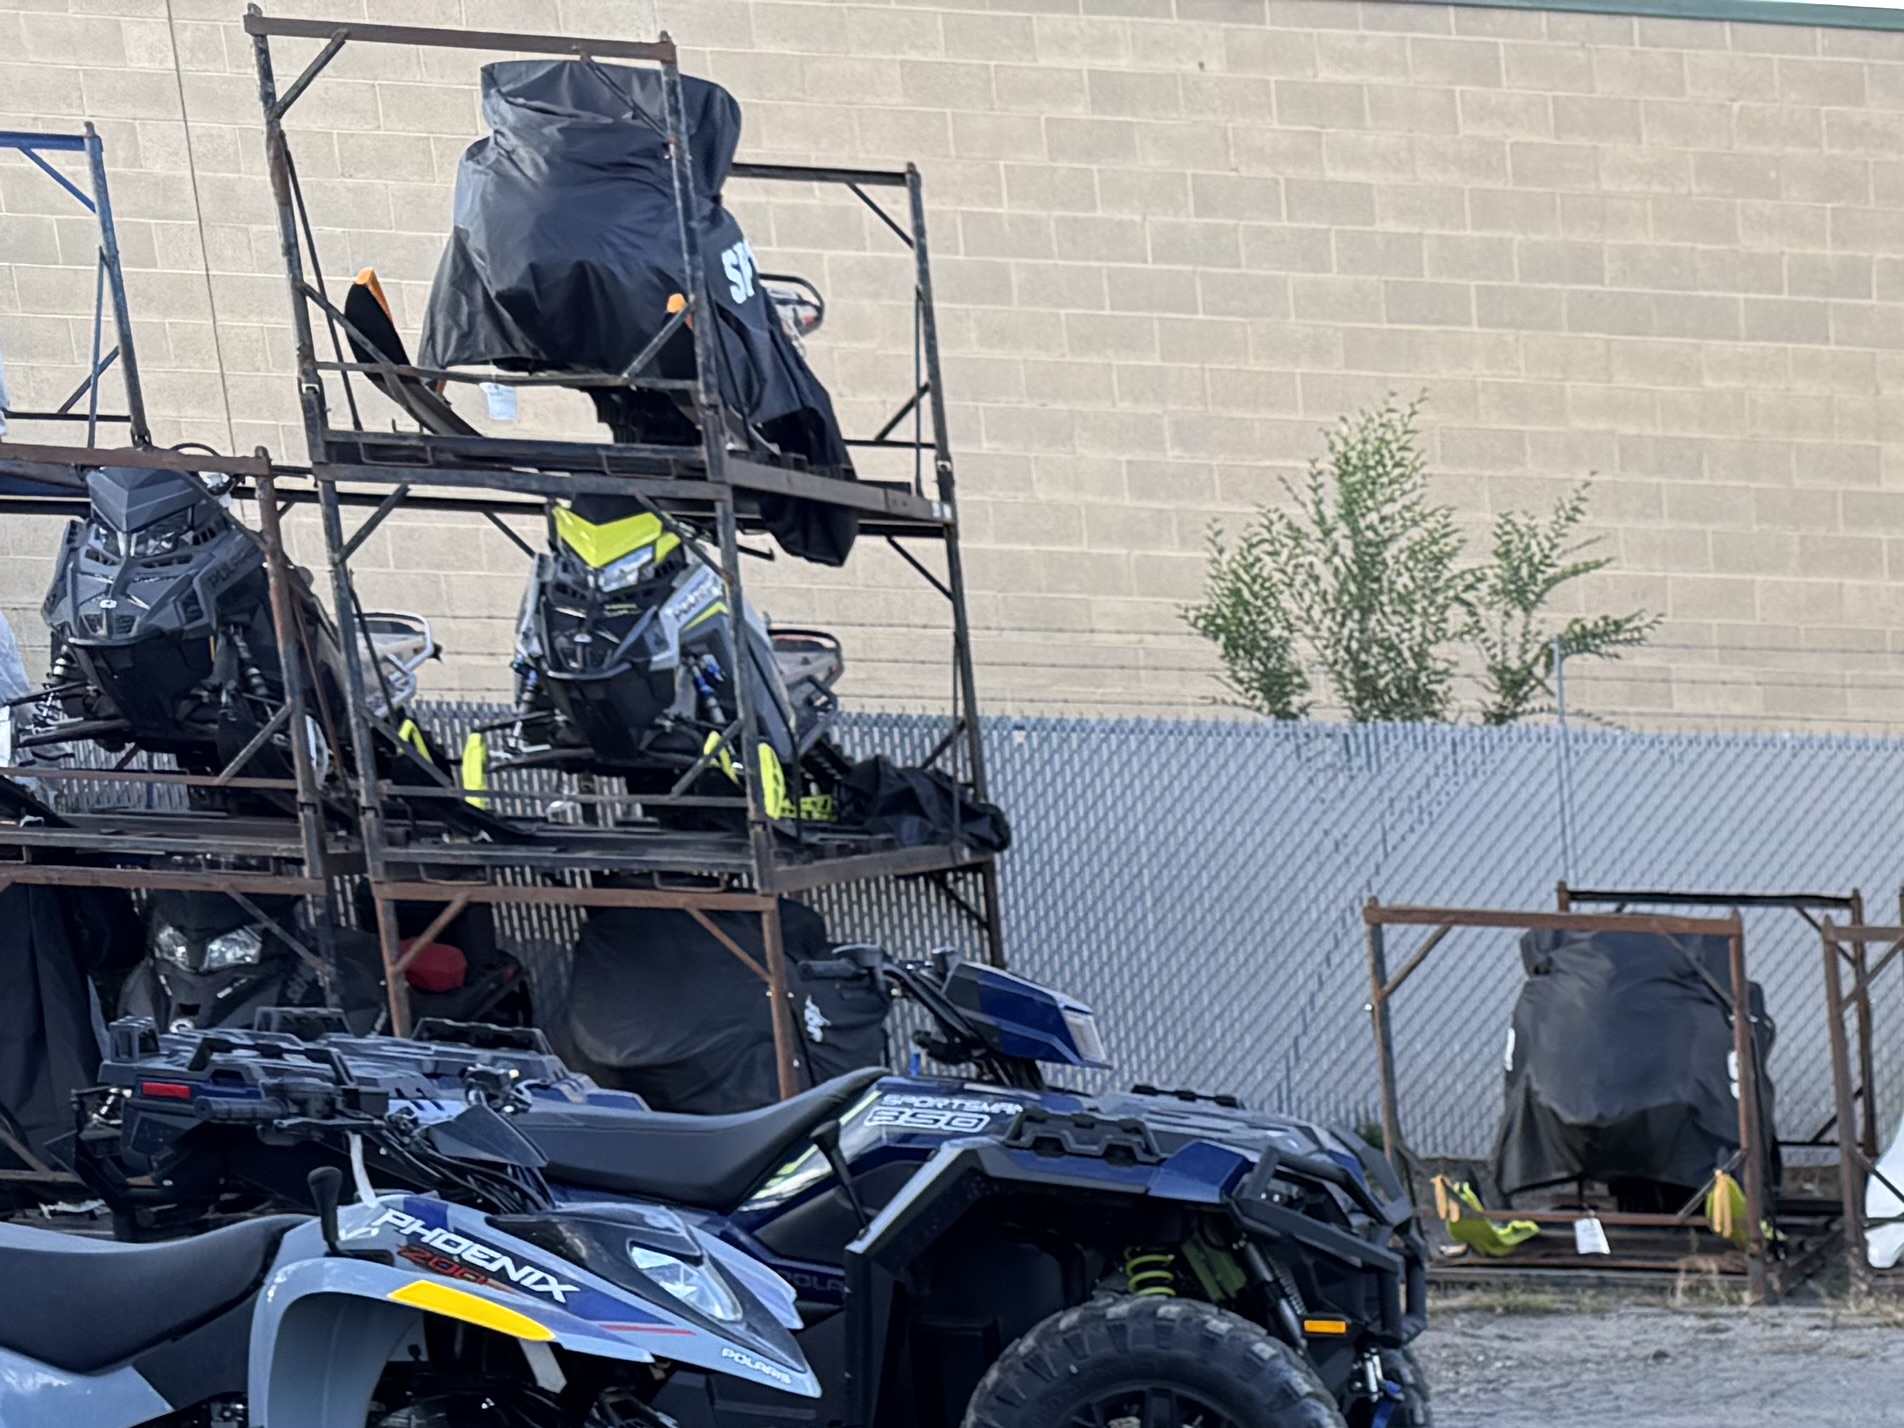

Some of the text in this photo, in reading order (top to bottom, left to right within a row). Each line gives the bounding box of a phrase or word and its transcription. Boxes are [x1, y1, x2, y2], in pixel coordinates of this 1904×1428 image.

[863, 1106, 991, 1133] 850
[371, 1208, 580, 1304] PHOENIX
[721, 1347, 792, 1385] POLARIS
